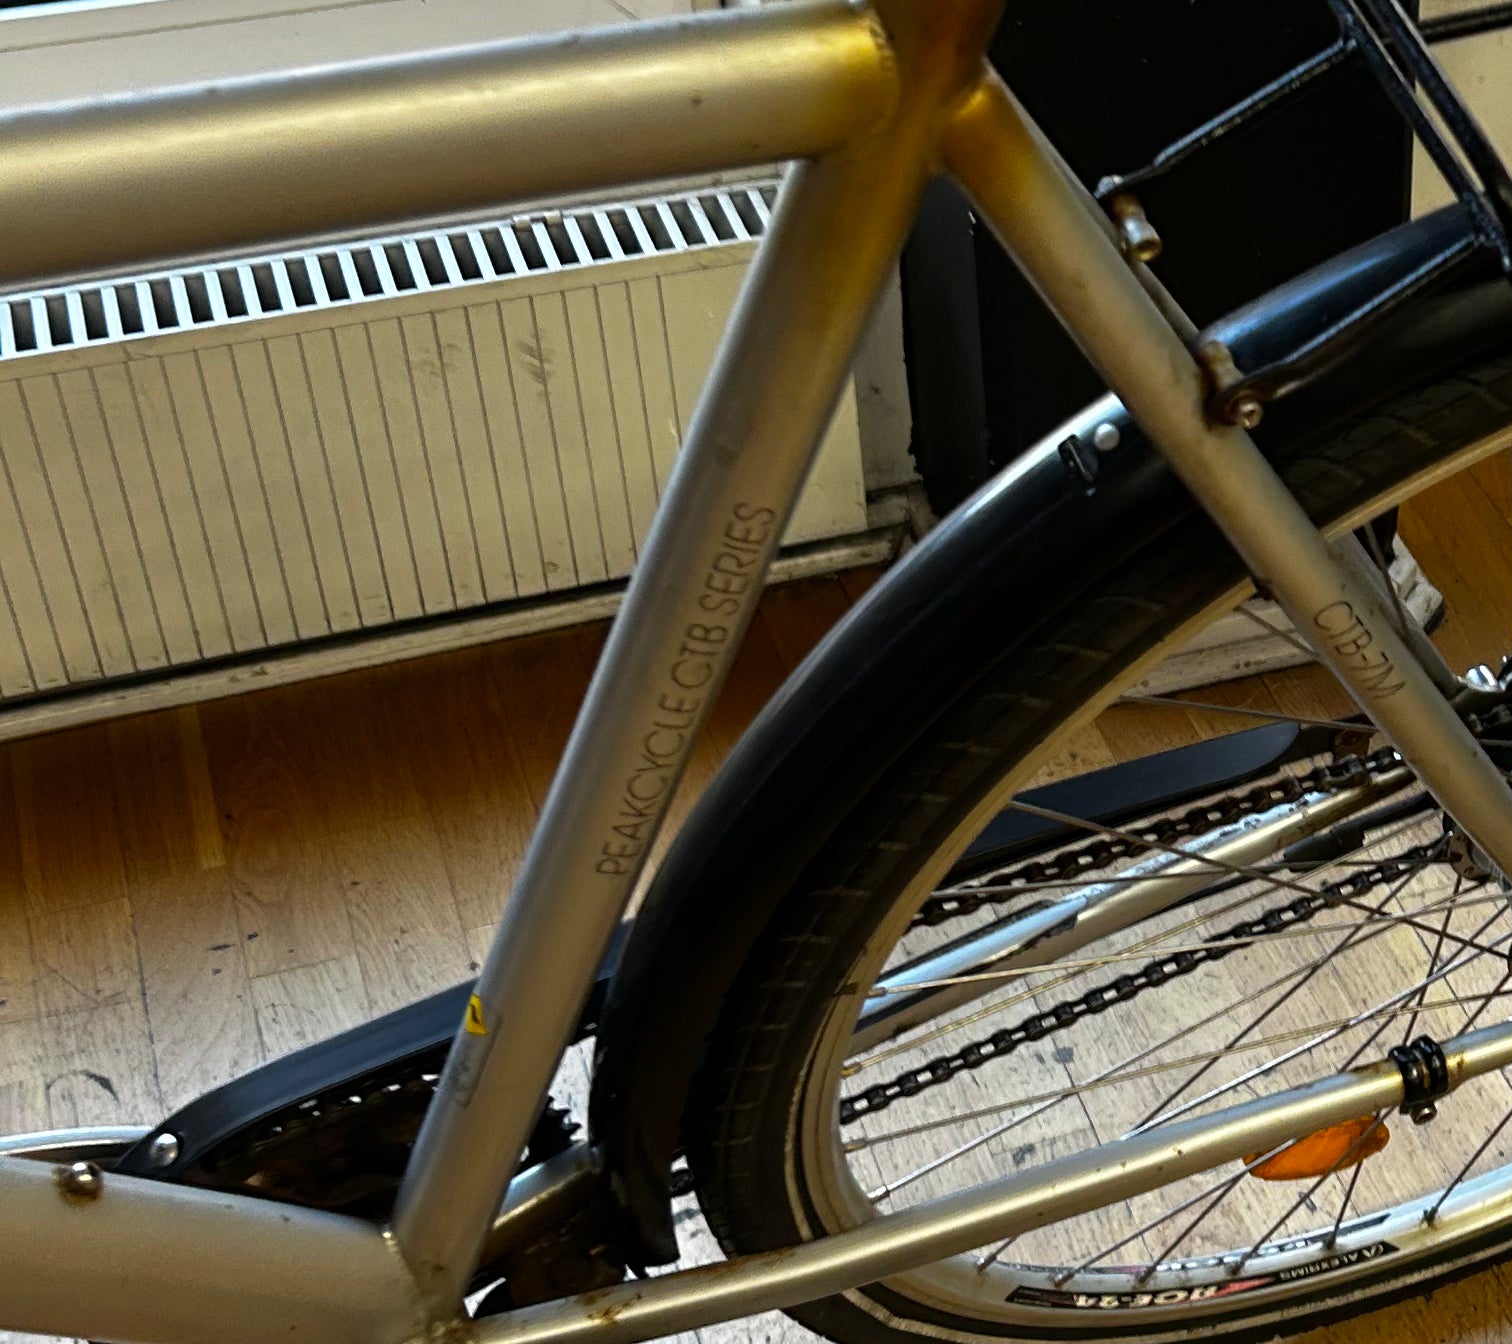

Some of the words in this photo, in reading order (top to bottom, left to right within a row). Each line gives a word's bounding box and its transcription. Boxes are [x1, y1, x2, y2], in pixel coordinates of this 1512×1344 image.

[700, 502, 775, 616] SERIES
[673, 622, 728, 689] CTB
[595, 693, 699, 877] PEAKCYCLE
[1279, 1250, 1359, 1280] ALEXRIMS
